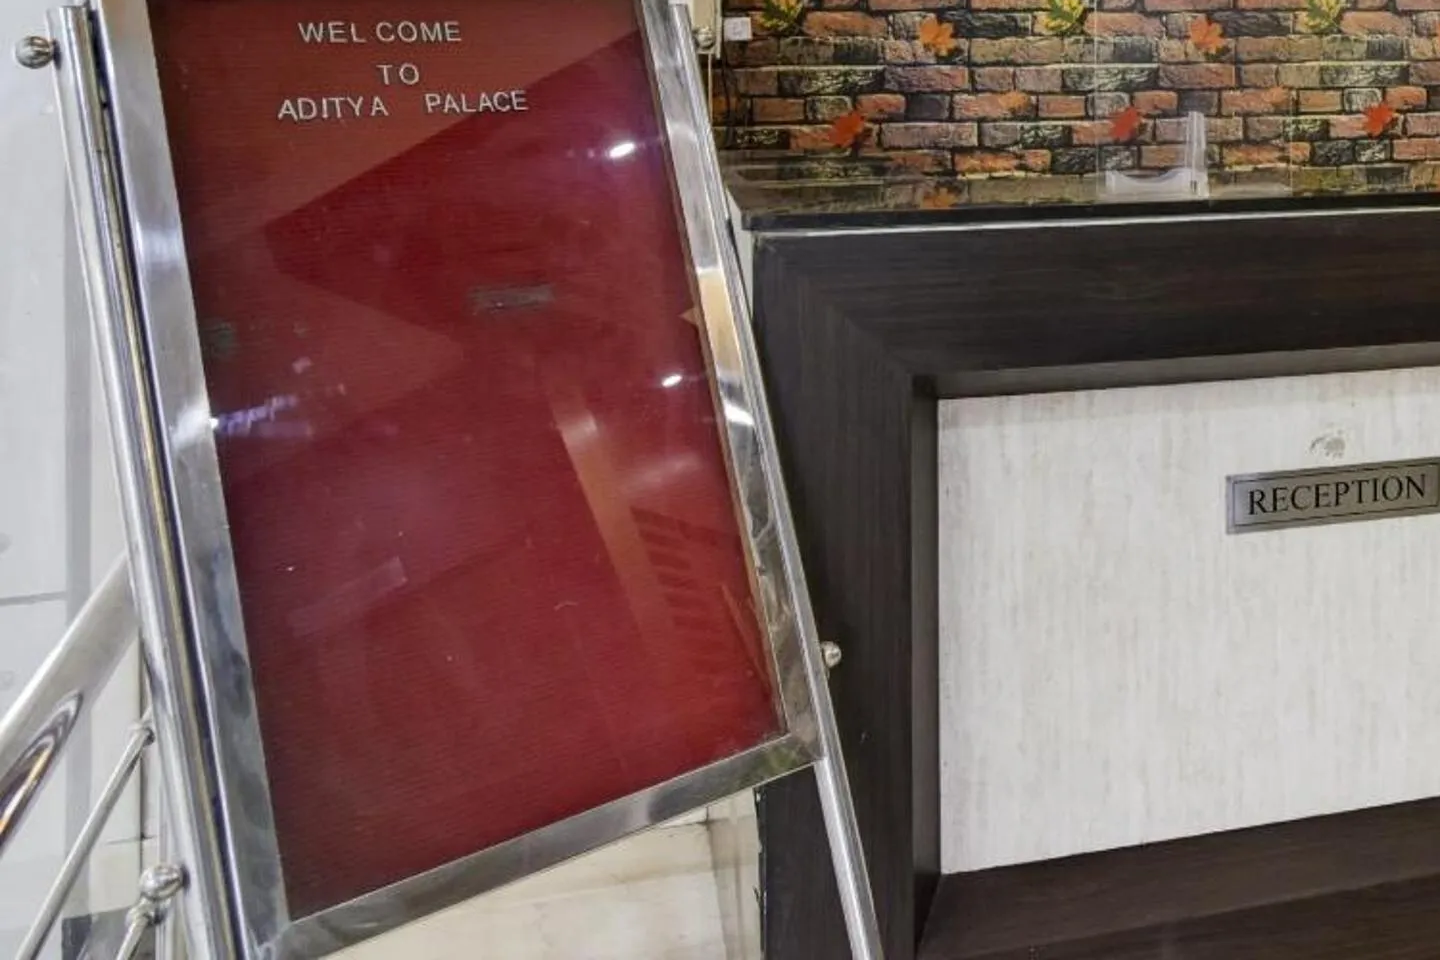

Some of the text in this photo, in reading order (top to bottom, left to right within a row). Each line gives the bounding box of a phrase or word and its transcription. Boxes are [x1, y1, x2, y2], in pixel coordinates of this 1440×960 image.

[298, 20, 462, 44] WELCOME
[376, 63, 420, 87] TO
[277, 89, 530, 123] ADITYA PALACE
[1248, 473, 1426, 516] RECEPTION
